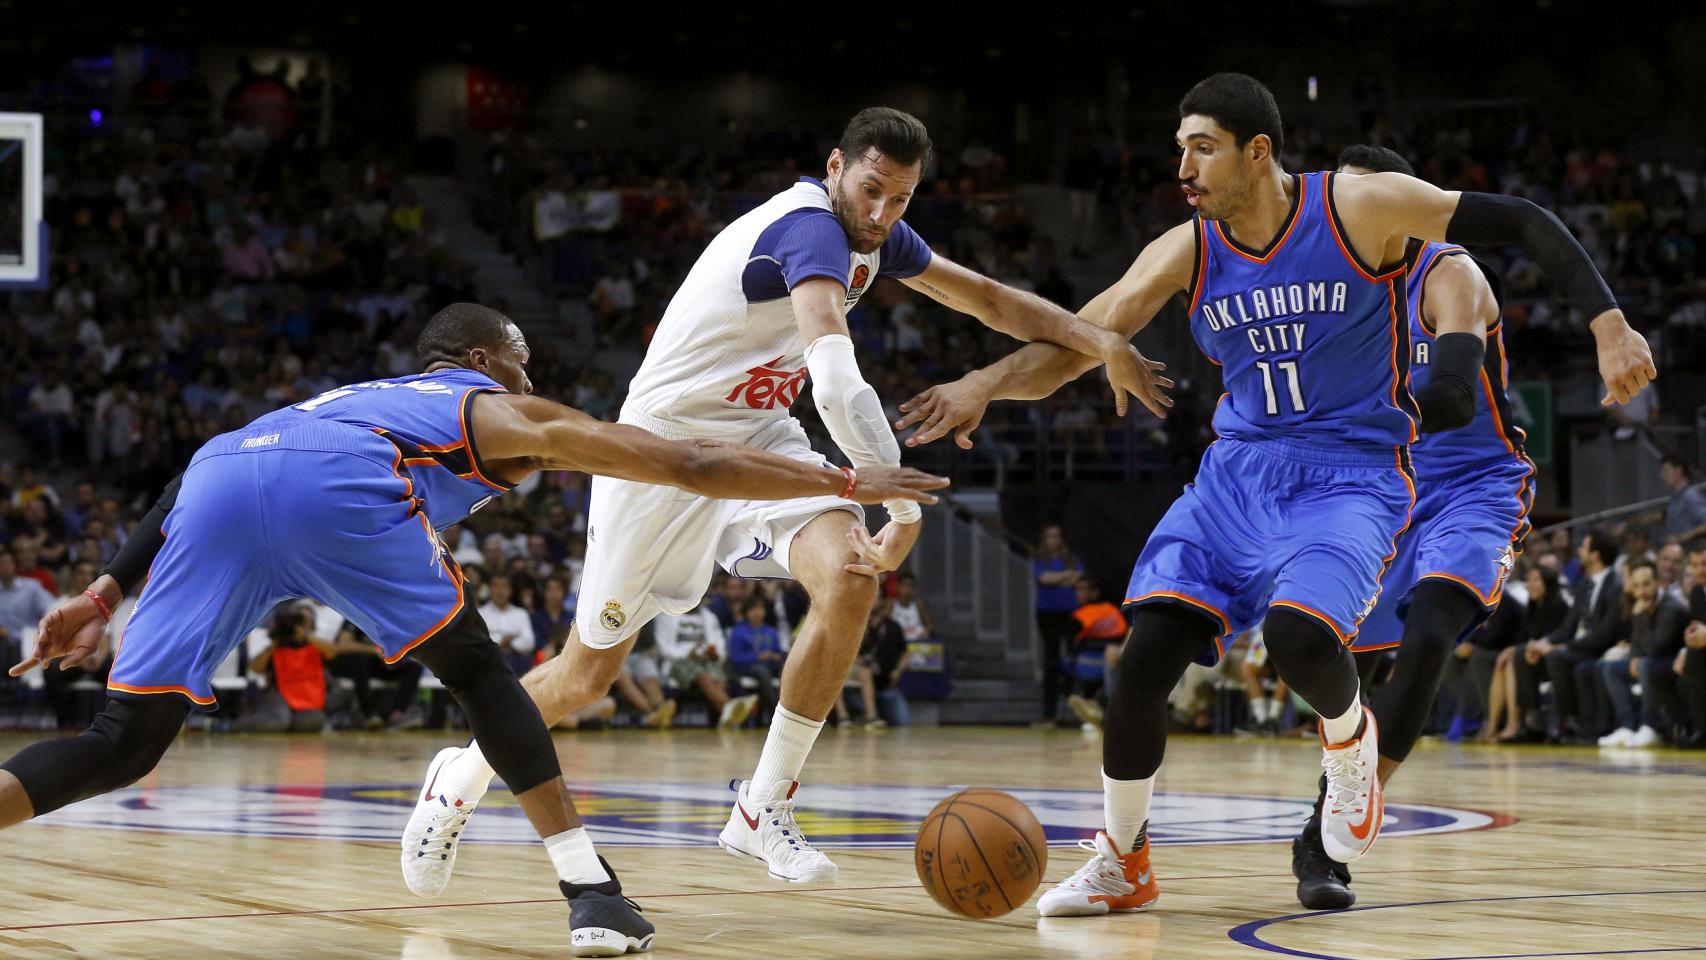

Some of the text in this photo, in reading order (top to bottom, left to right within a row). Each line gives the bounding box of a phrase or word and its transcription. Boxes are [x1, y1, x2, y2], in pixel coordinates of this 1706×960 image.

[1201, 281, 1348, 333] OKLAHOMA
[1247, 322, 1306, 354] CITY
[1416, 342, 1429, 364] A
[1256, 360, 1306, 415] 11
[240, 432, 281, 448] THUNDER
